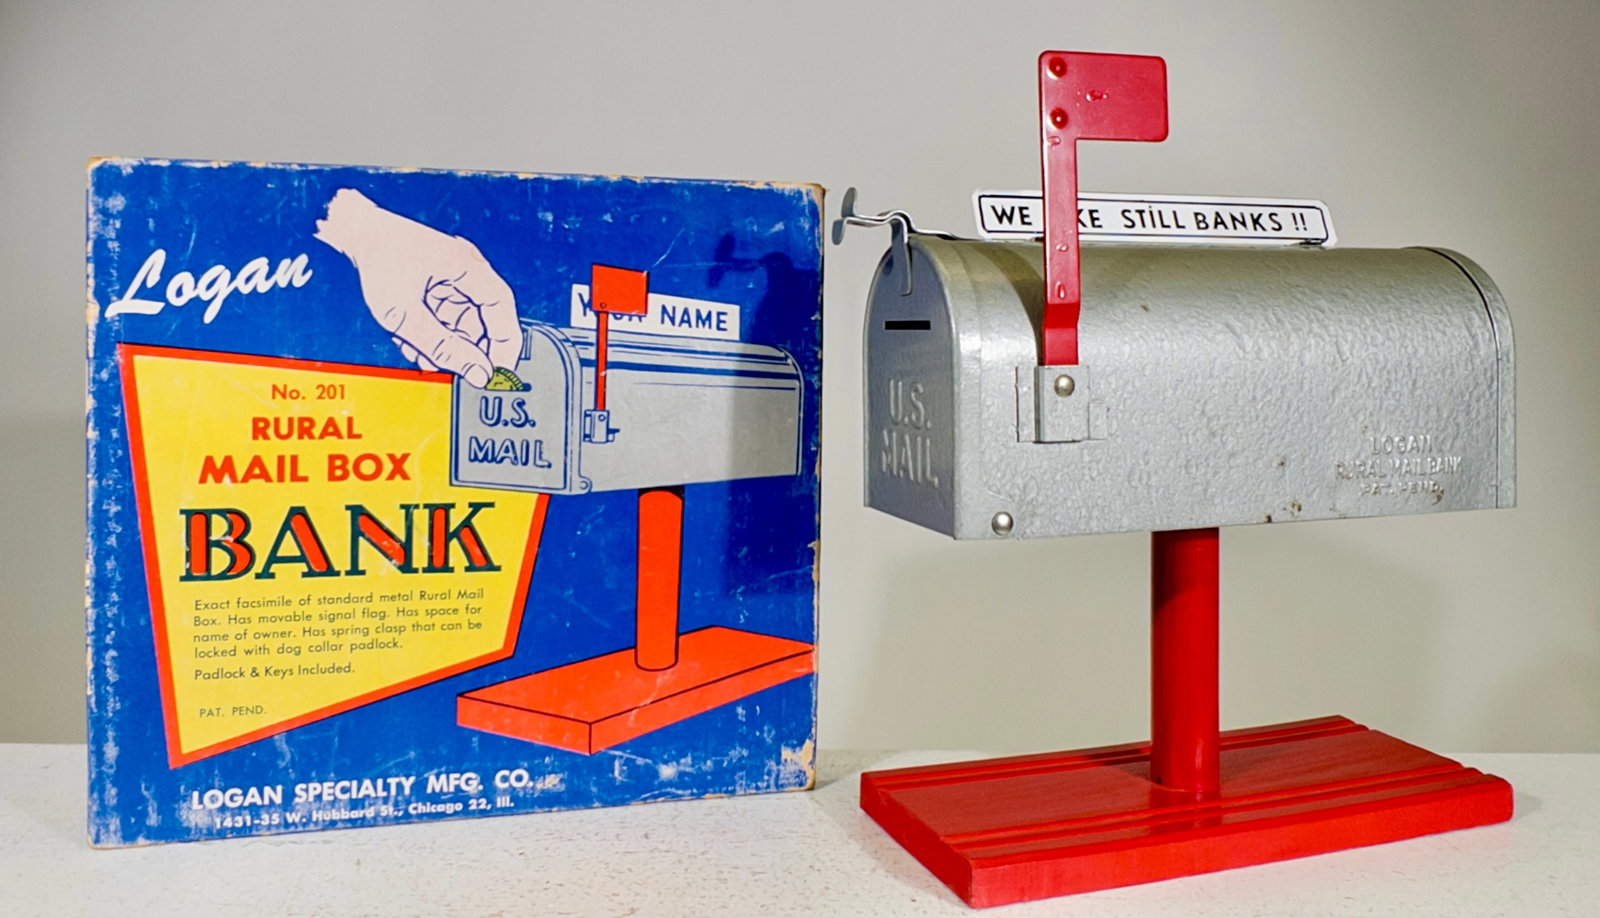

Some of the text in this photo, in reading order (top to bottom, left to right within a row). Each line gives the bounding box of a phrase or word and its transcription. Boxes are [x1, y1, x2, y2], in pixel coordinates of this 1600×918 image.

[991, 205, 1032, 226] WE
[1193, 211, 1283, 232] BANKS
[105, 249, 313, 324] Logan
[660, 305, 728, 332] NAME
[271, 384, 346, 401] No. 201
[890, 379, 931, 430] U.S.
[479, 396, 536, 428] U.S.
[251, 417, 363, 441] RURAL
[468, 436, 552, 469] MAIL
[881, 429, 938, 487] MAIL
[1370, 434, 1433, 455] LOGAN
[199, 453, 412, 485] MAIL BOX
[179, 502, 502, 582] BANK
[194, 588, 484, 611] Exact facsimile of standard metal Rural Mail
[193, 603, 482, 627] Box. Has movable signal flag. Has space for
[193, 619, 482, 643] name of owner. Has spring clasp that can be
[194, 637, 403, 659] locked with dog collar padlock.
[194, 661, 355, 680] Padlock & Keys Included.
[200, 704, 267, 718] PAT. PEND.
[191, 768, 534, 810] LOGAN SPECIALTY MFG. CO.
[215, 796, 514, 829] 1431-35 W. Hubbard St., Chicago 22, Ill.
